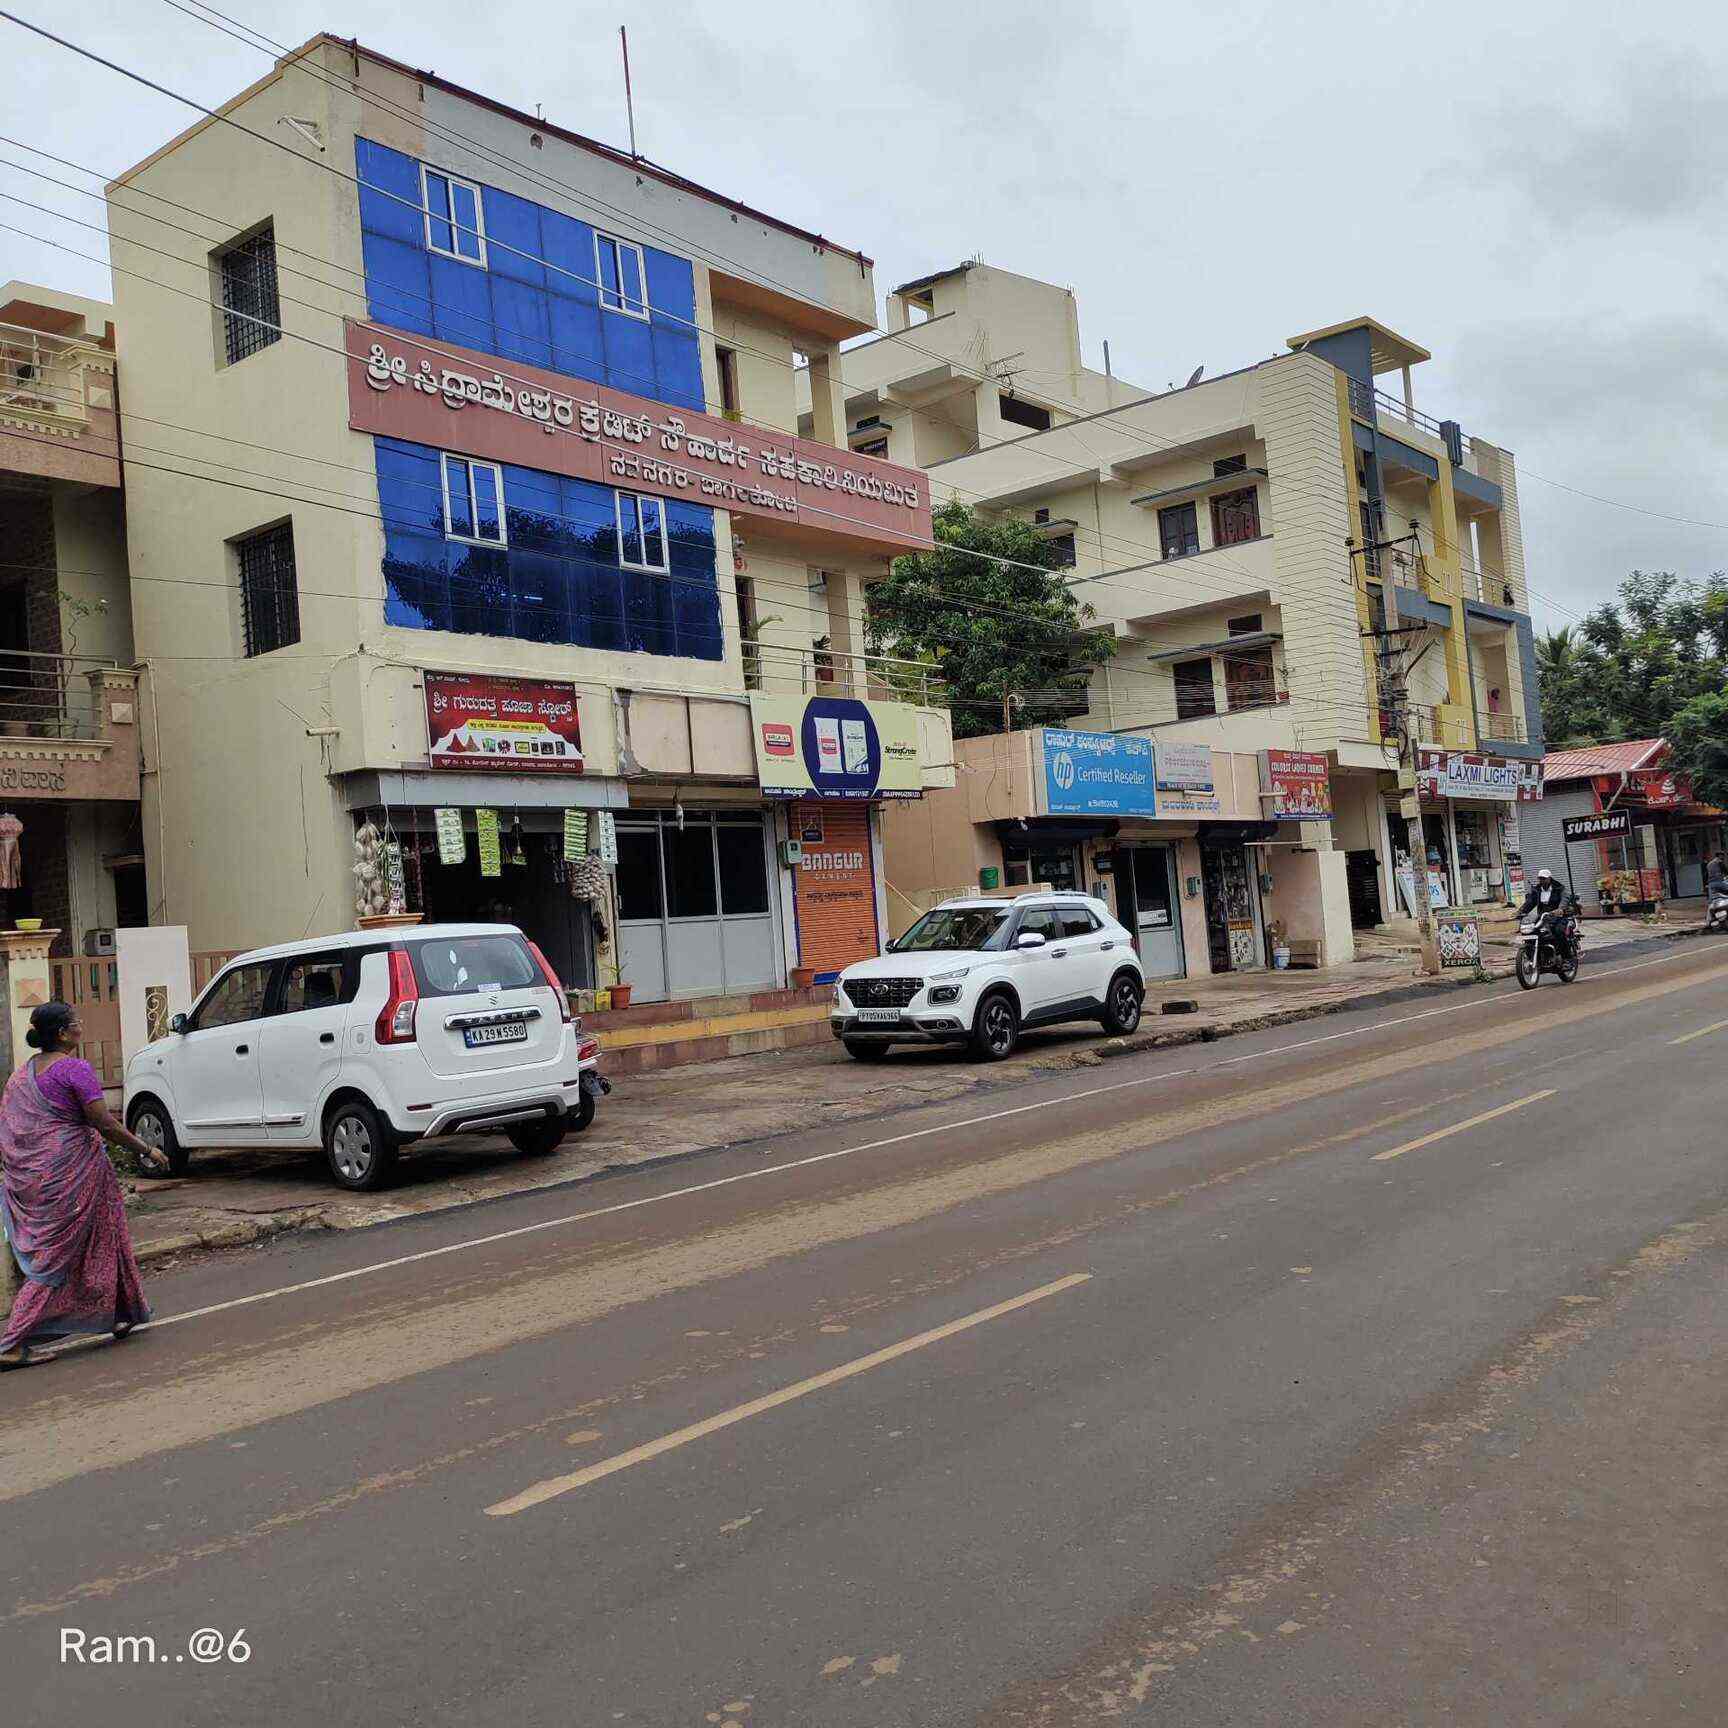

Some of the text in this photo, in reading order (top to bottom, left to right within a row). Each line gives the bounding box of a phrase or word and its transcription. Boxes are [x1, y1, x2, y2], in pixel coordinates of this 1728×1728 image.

[366, 343, 406, 391] ಶ್ರೀ
[433, 691, 448, 713] ಶ್ರೀ
[1077, 766, 1113, 783] Certified
[1114, 769, 1146, 785] Reseller
[1448, 764, 1518, 785] LAXMI LIGHTS
[1566, 816, 1625, 835] SURABHI
